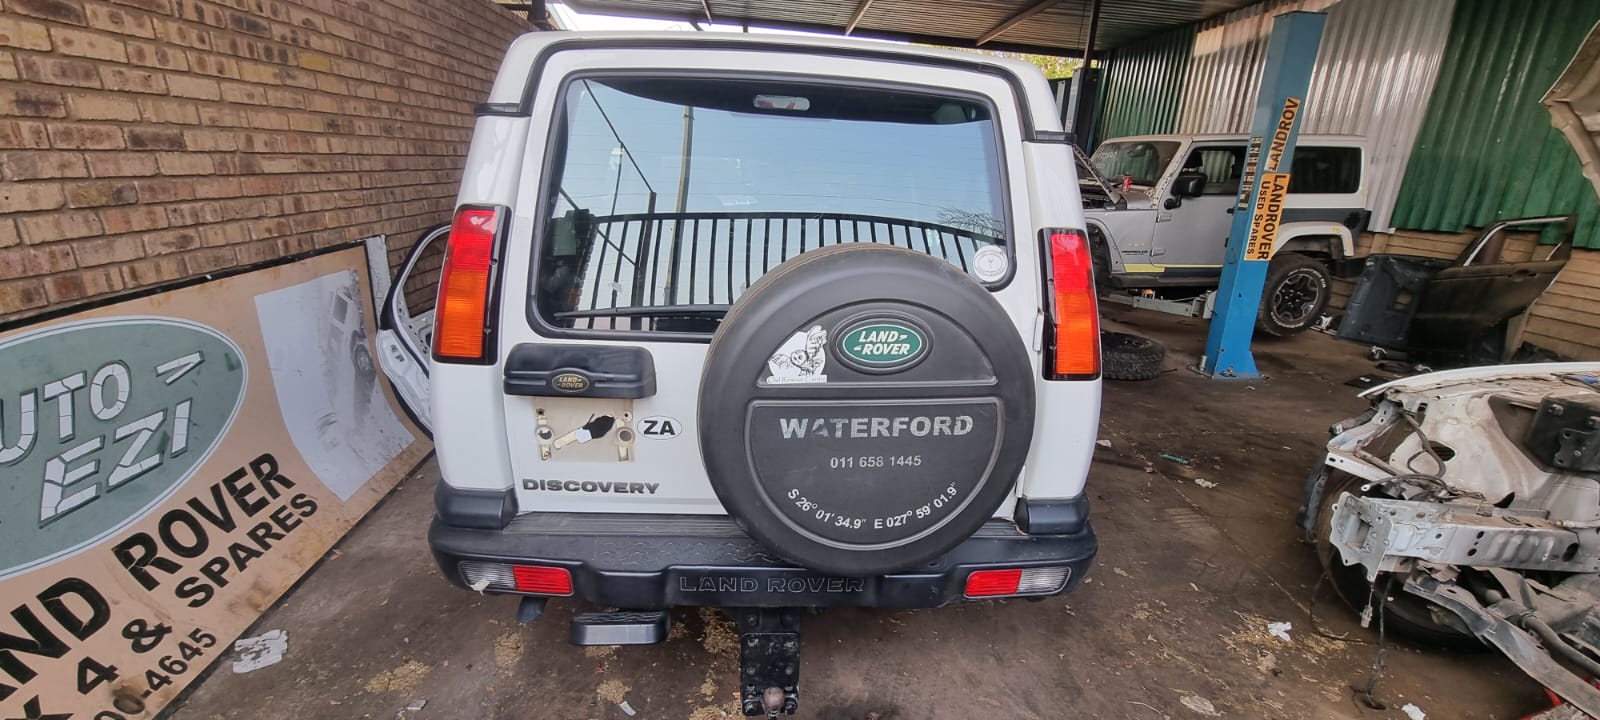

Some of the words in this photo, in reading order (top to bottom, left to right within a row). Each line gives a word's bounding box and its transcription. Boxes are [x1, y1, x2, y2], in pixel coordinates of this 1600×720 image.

[1269, 98, 1299, 171] LANDROV
[1256, 181, 1271, 210] USED
[1256, 174, 1287, 260] LANDROVER
[1247, 213, 1264, 254] SPARES
[859, 330, 899, 343] LAND
[861, 343, 911, 356] ROVER
[643, 420, 676, 436] ZA
[779, 415, 974, 439] WATERFORD
[39, 397, 193, 528] EZI
[830, 457, 854, 469] 011
[859, 456, 884, 467] 658
[889, 455, 922, 467] 1445
[521, 478, 661, 495] DISCOVERY
[788, 488, 800, 500] S
[874, 518, 884, 529] E
[0, 577, 111, 701] ND
[111, 453, 296, 591] ROVER
[679, 576, 760, 592] LAND
[767, 577, 865, 592] ROVER
[77, 656, 119, 695] 4
[122, 618, 172, 654] &
[174, 492, 319, 608] SPARES
